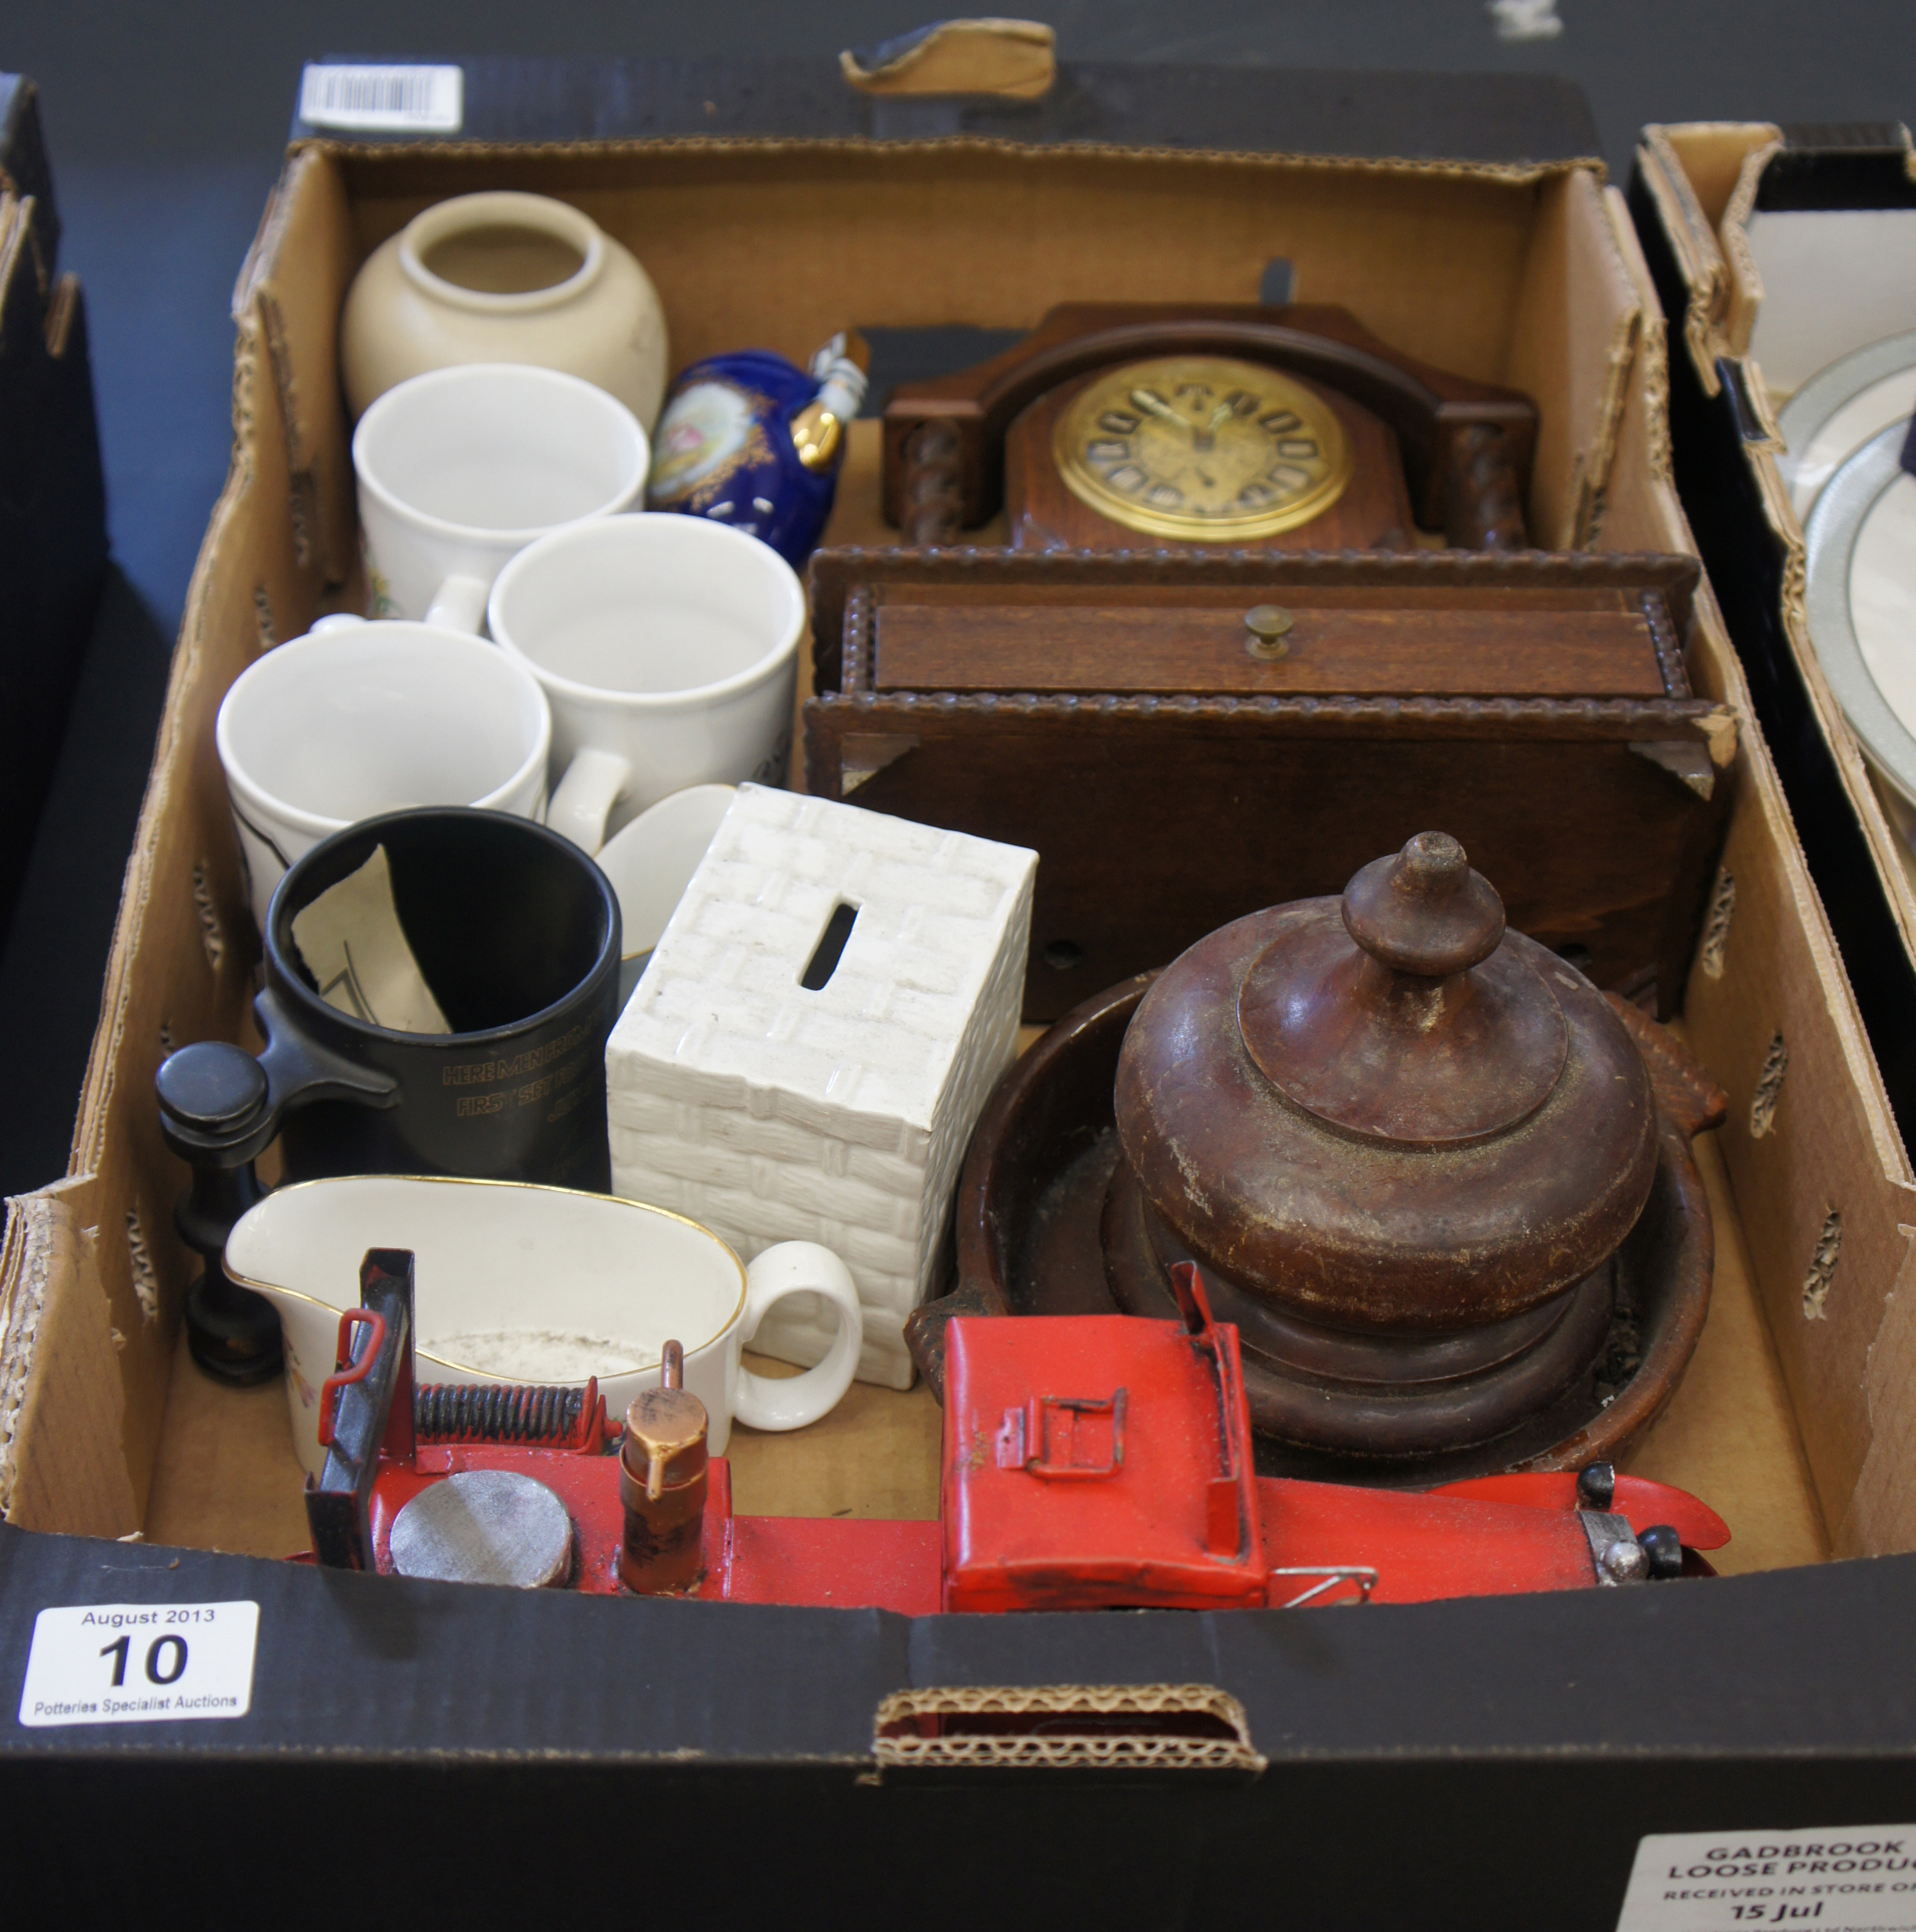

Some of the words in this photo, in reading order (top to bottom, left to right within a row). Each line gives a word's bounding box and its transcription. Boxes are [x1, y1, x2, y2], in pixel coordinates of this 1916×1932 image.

[443, 1062, 495, 1085] HERE
[497, 1047, 544, 1079] MEN
[456, 1090, 517, 1117] FIRST
[518, 1073, 554, 1106] SET
[81, 1612, 158, 1627] August
[165, 1609, 215, 1623] 2013
[99, 1634, 188, 1687] 10
[34, 1700, 97, 1716] Potteries
[102, 1697, 171, 1714] Specialist
[174, 1695, 238, 1709] Auctions
[1705, 1840, 1905, 1861] GADBROOK
[1668, 1862, 1778, 1879] LOOSE
[1787, 1857, 1916, 1875] PRODU
[1663, 1888, 1774, 1901] RECEIVED
[1779, 1886, 1806, 1896] IN
[1811, 1883, 1885, 1895] STORE
[1730, 1905, 1766, 1920] 15
[1769, 1901, 1824, 1923] Jul
